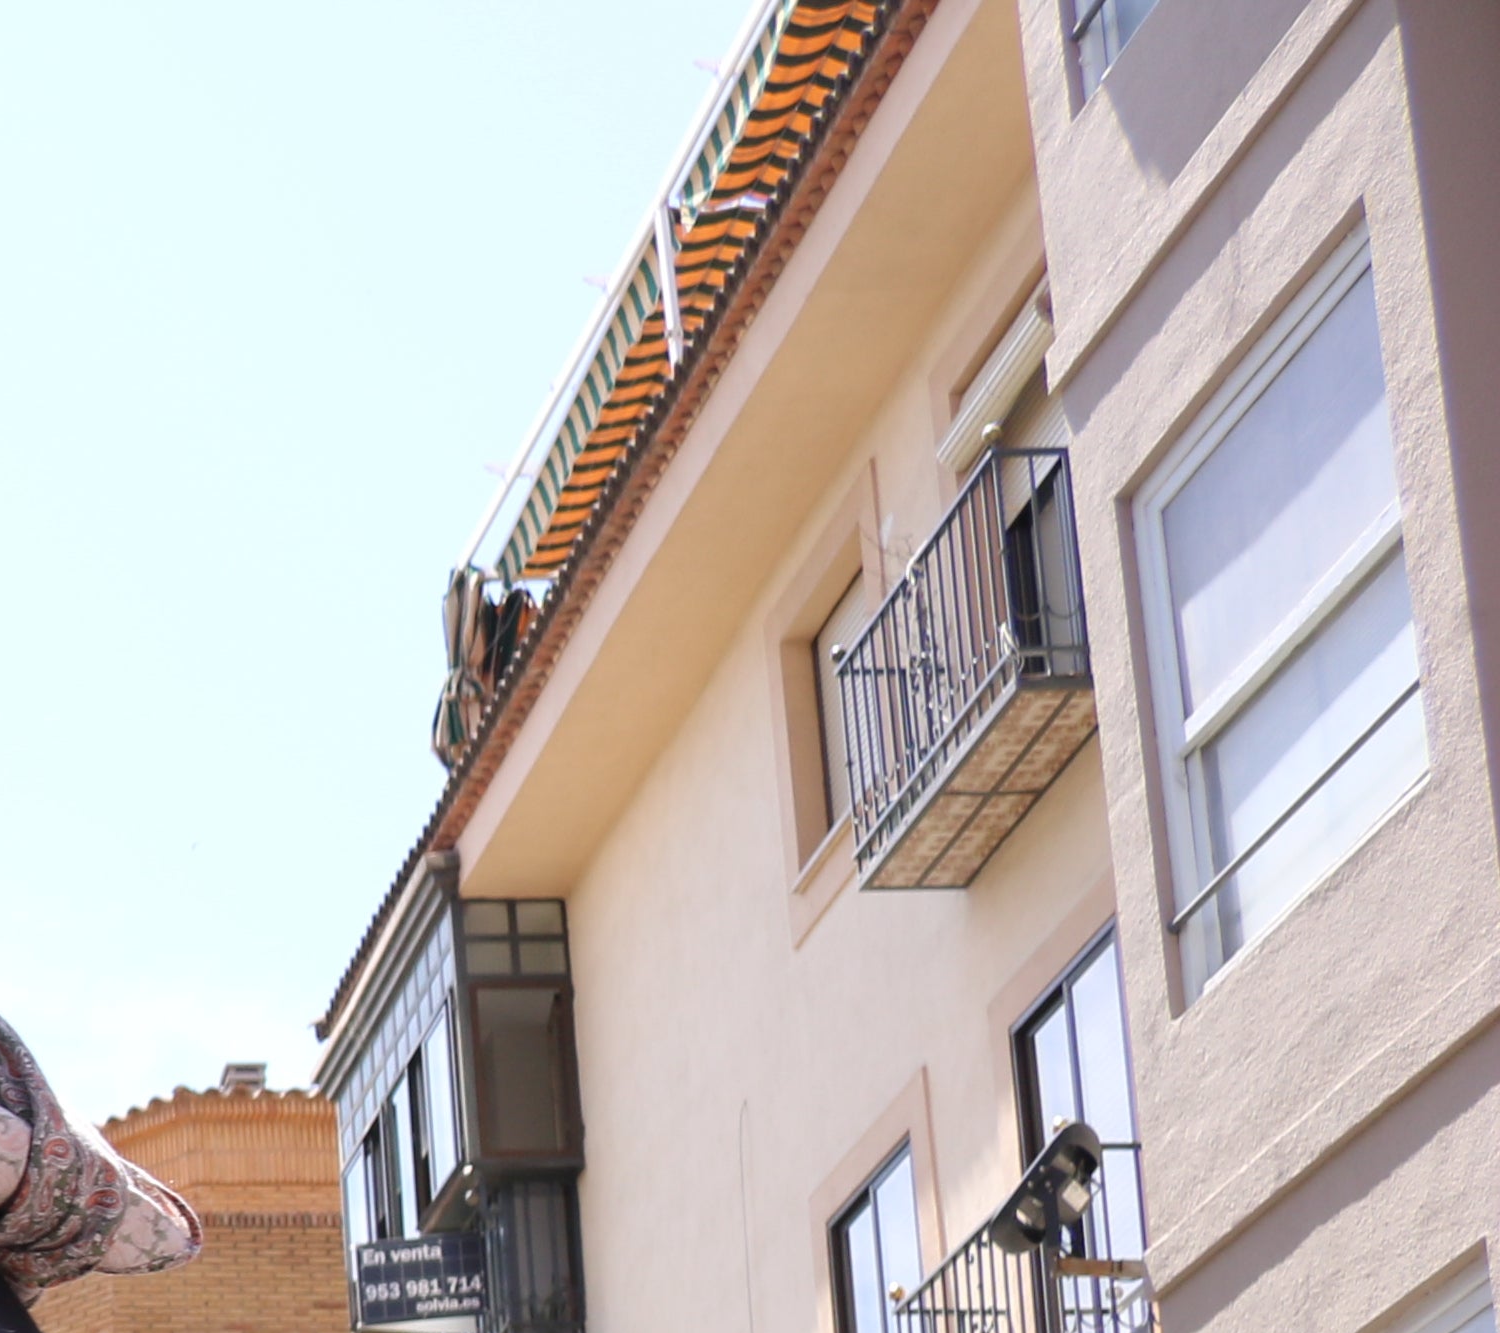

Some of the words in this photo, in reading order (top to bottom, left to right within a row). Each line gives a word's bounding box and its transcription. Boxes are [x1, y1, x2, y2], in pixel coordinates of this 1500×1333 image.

[362, 1247, 386, 1266] En
[390, 1243, 442, 1262] venta
[365, 1281, 401, 1302] 953
[406, 1278, 442, 1297] 981
[447, 1274, 483, 1294] 714
[416, 1296, 481, 1313] solvia.es
